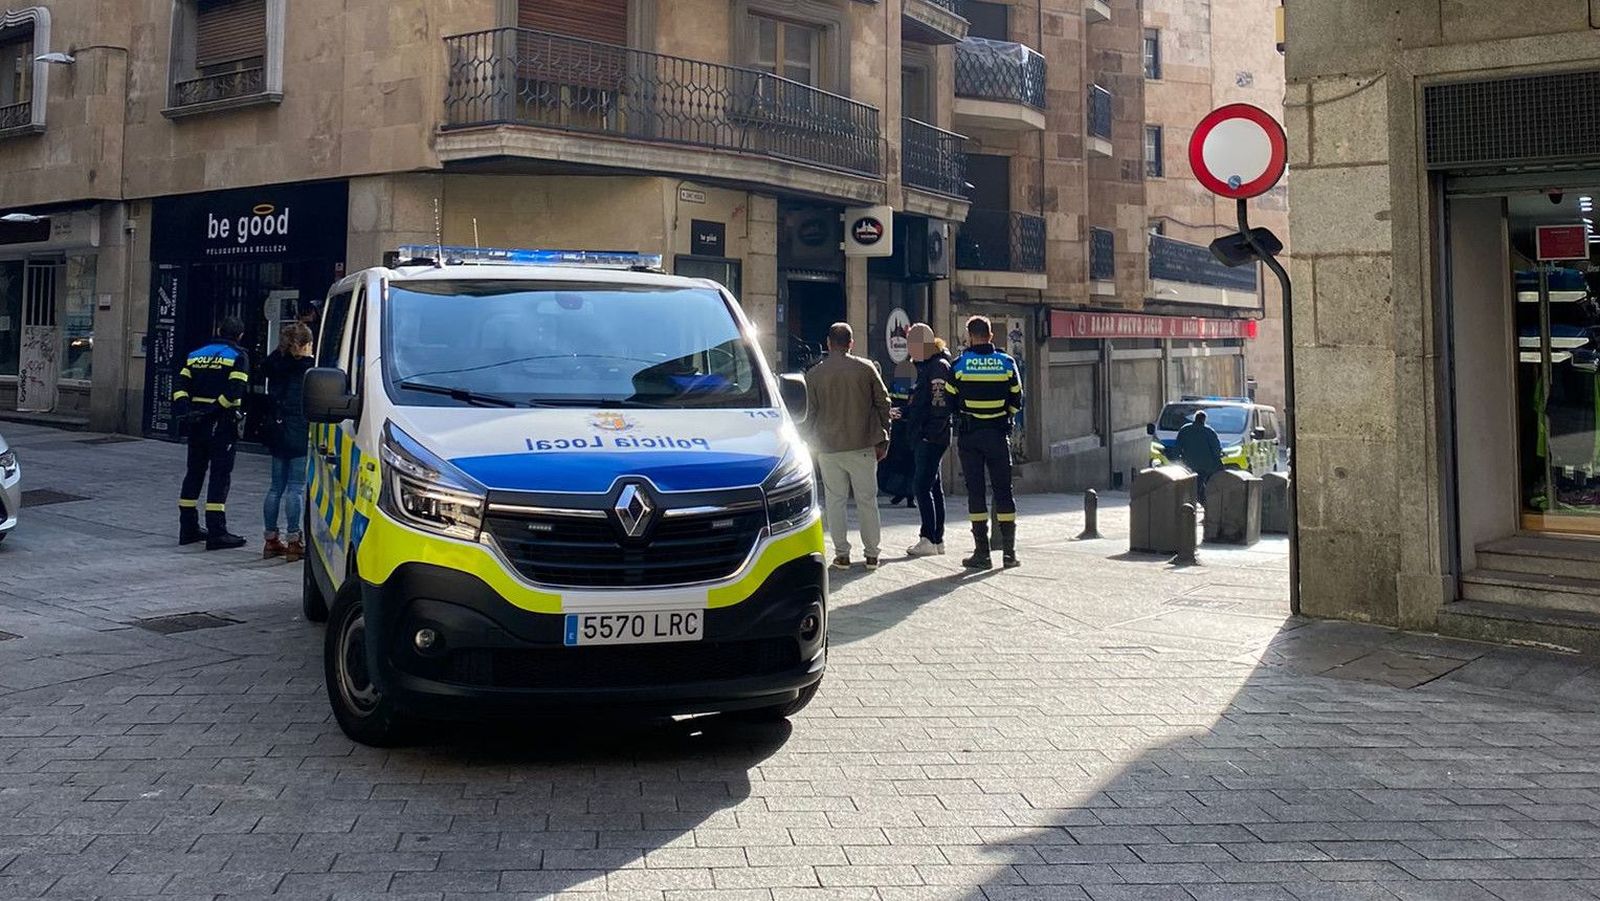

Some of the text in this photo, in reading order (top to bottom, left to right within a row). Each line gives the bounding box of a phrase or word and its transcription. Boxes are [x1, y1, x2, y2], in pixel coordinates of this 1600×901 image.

[208, 207, 289, 244] be good
[255, 244, 287, 253] BELLEZA
[966, 358, 1003, 366] POLICIA
[583, 614, 645, 639] 5570
[654, 611, 698, 637] LRC
